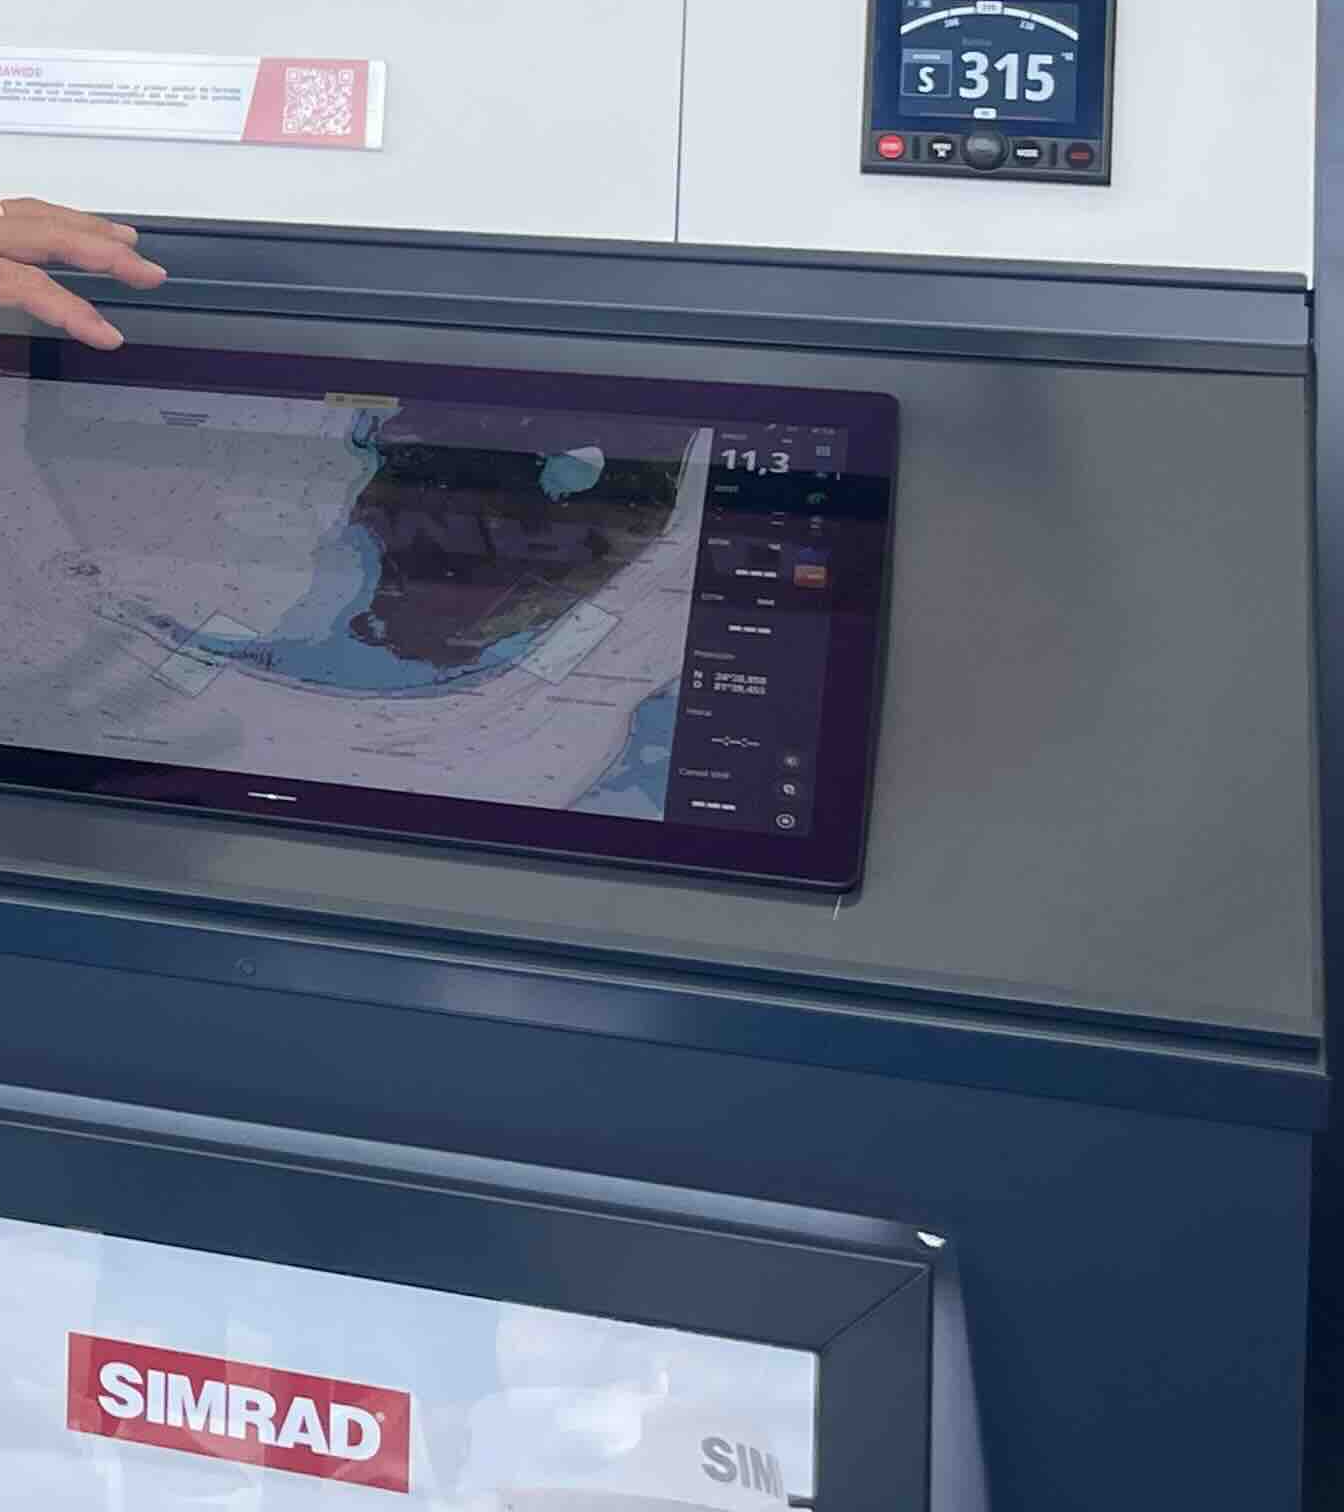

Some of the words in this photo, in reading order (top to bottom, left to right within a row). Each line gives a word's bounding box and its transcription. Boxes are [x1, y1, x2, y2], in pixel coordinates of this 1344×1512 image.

[917, 66, 936, 93] S
[959, 51, 1055, 101] 315
[98, 1361, 382, 1461] SIMRAD
